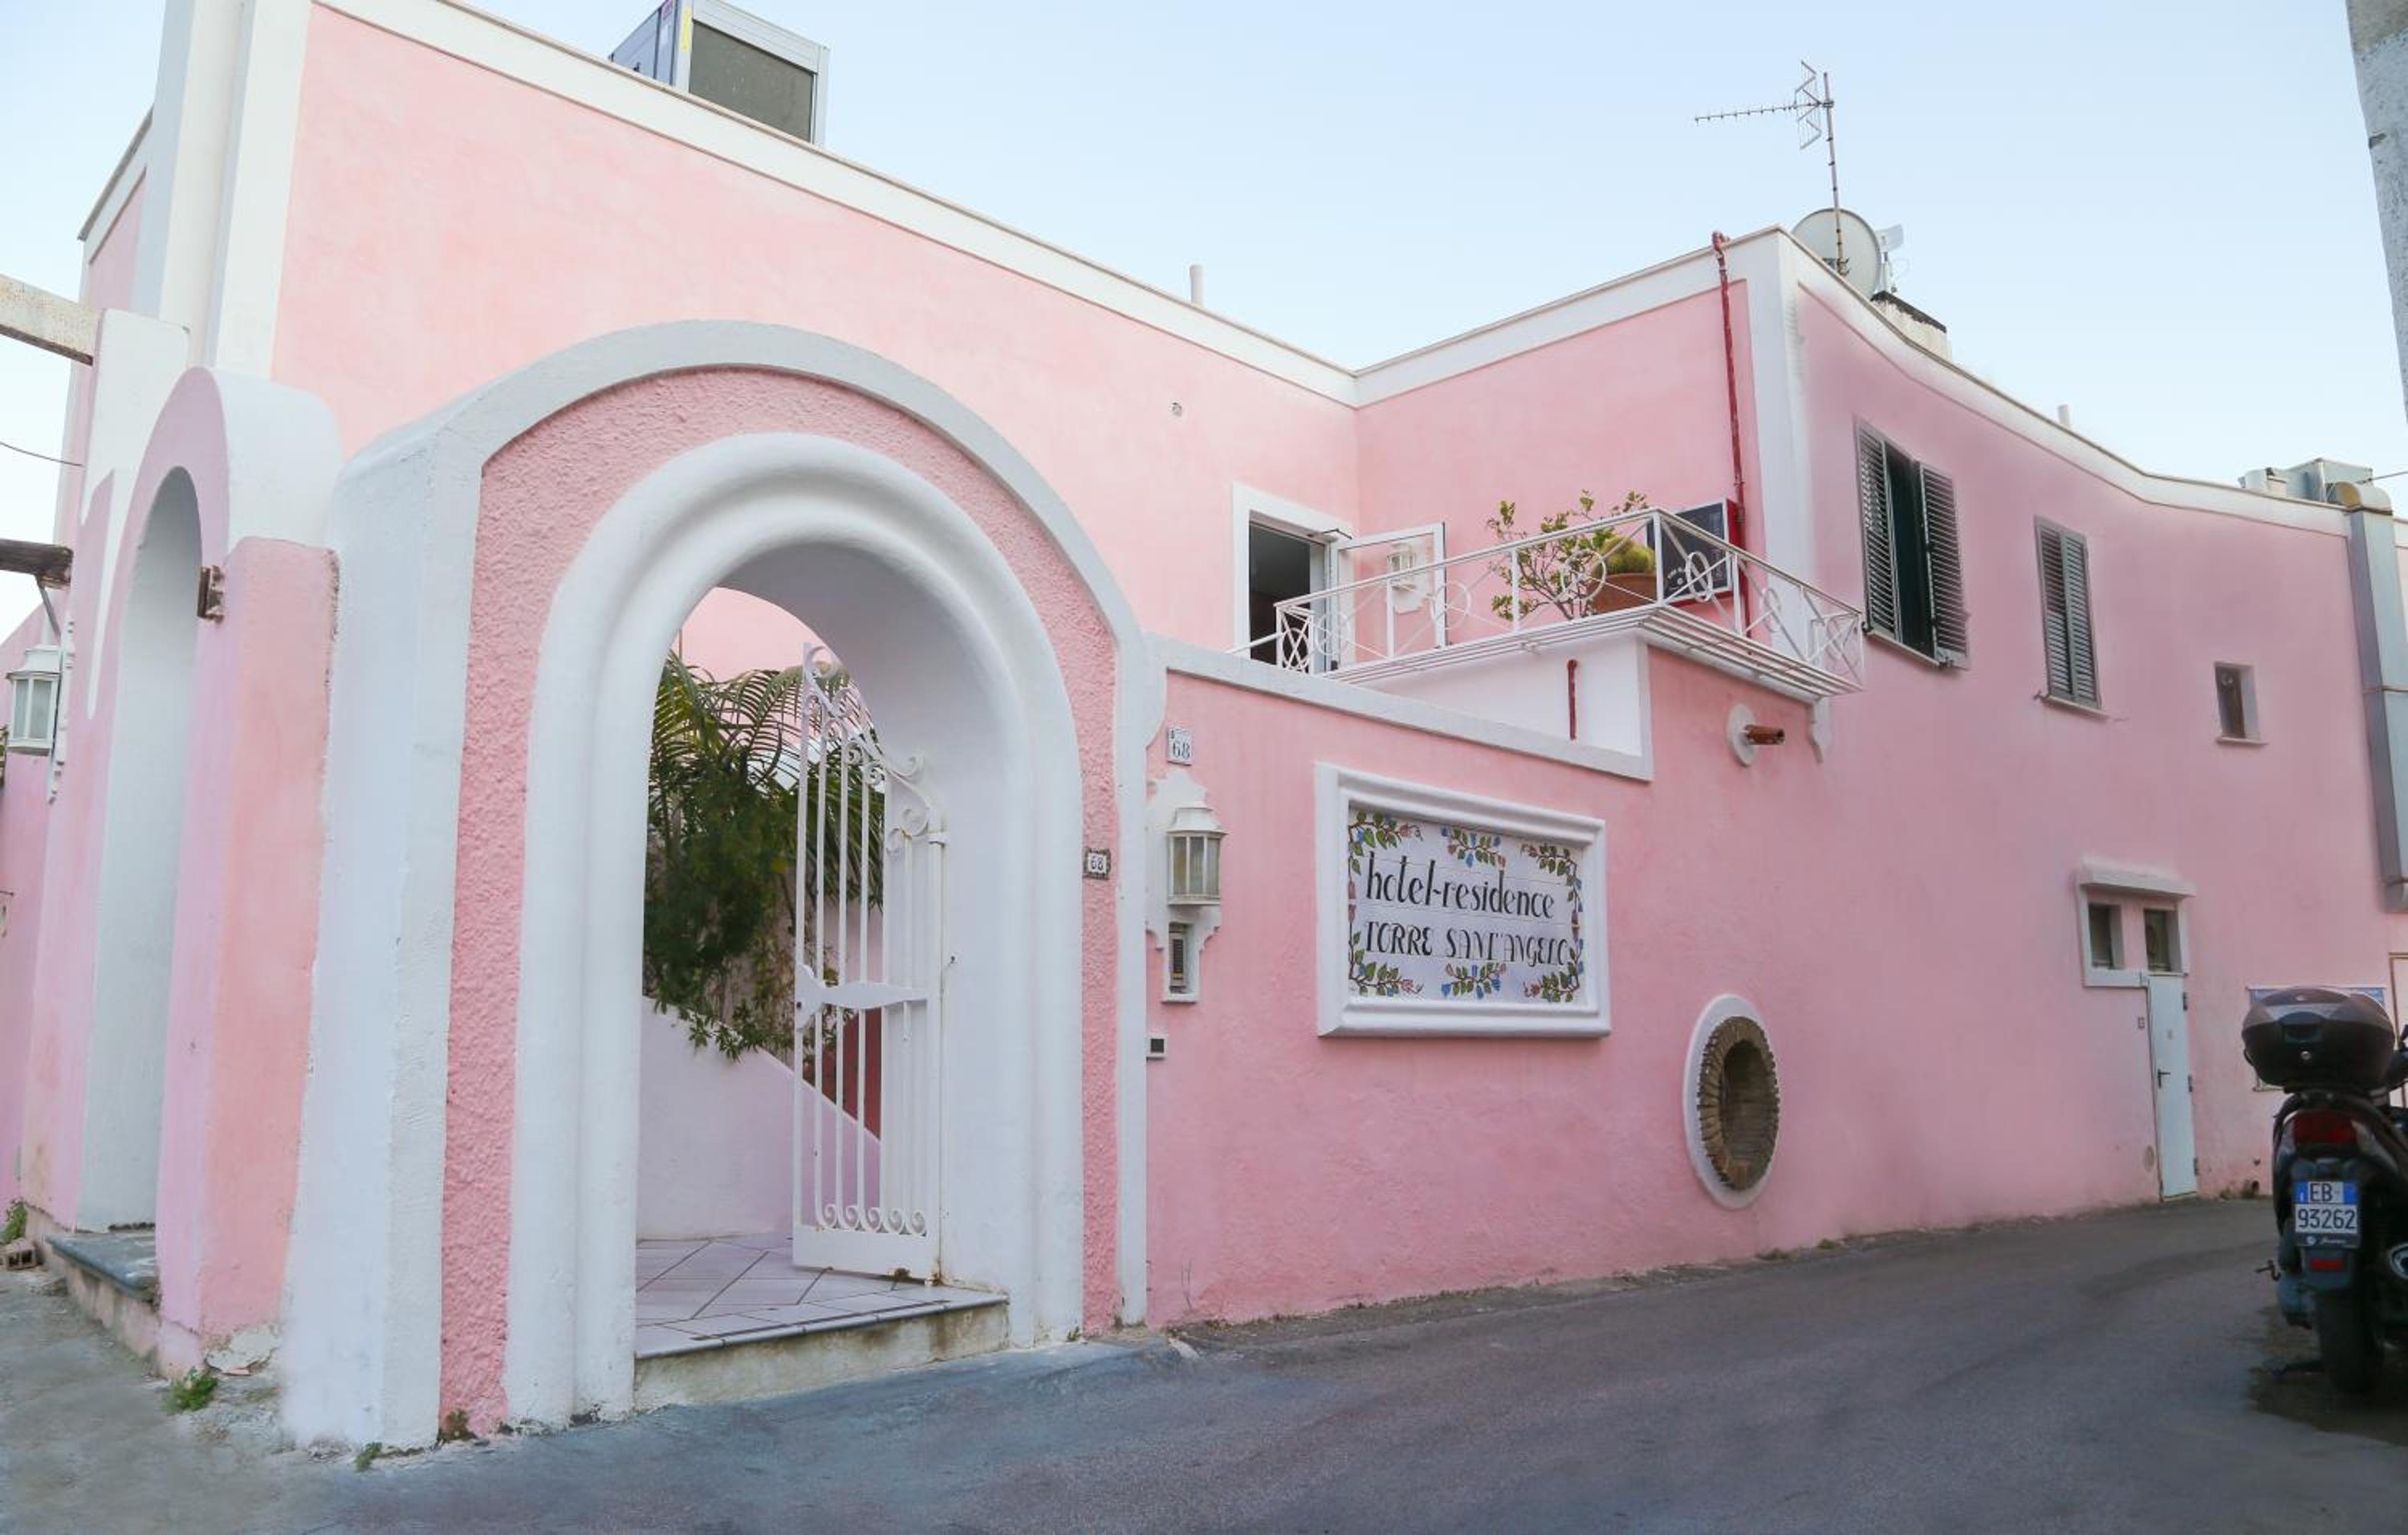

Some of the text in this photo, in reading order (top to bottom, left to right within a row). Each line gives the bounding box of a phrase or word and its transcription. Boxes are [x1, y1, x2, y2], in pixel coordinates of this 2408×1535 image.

[1173, 739, 1190, 759] 68
[1092, 855, 1104, 870] 68
[1365, 851, 1555, 918] hotel-residence
[1365, 921, 1433, 956] TORRE
[2310, 1183, 2333, 1202] EB
[2298, 1208, 2357, 1230] 93262
